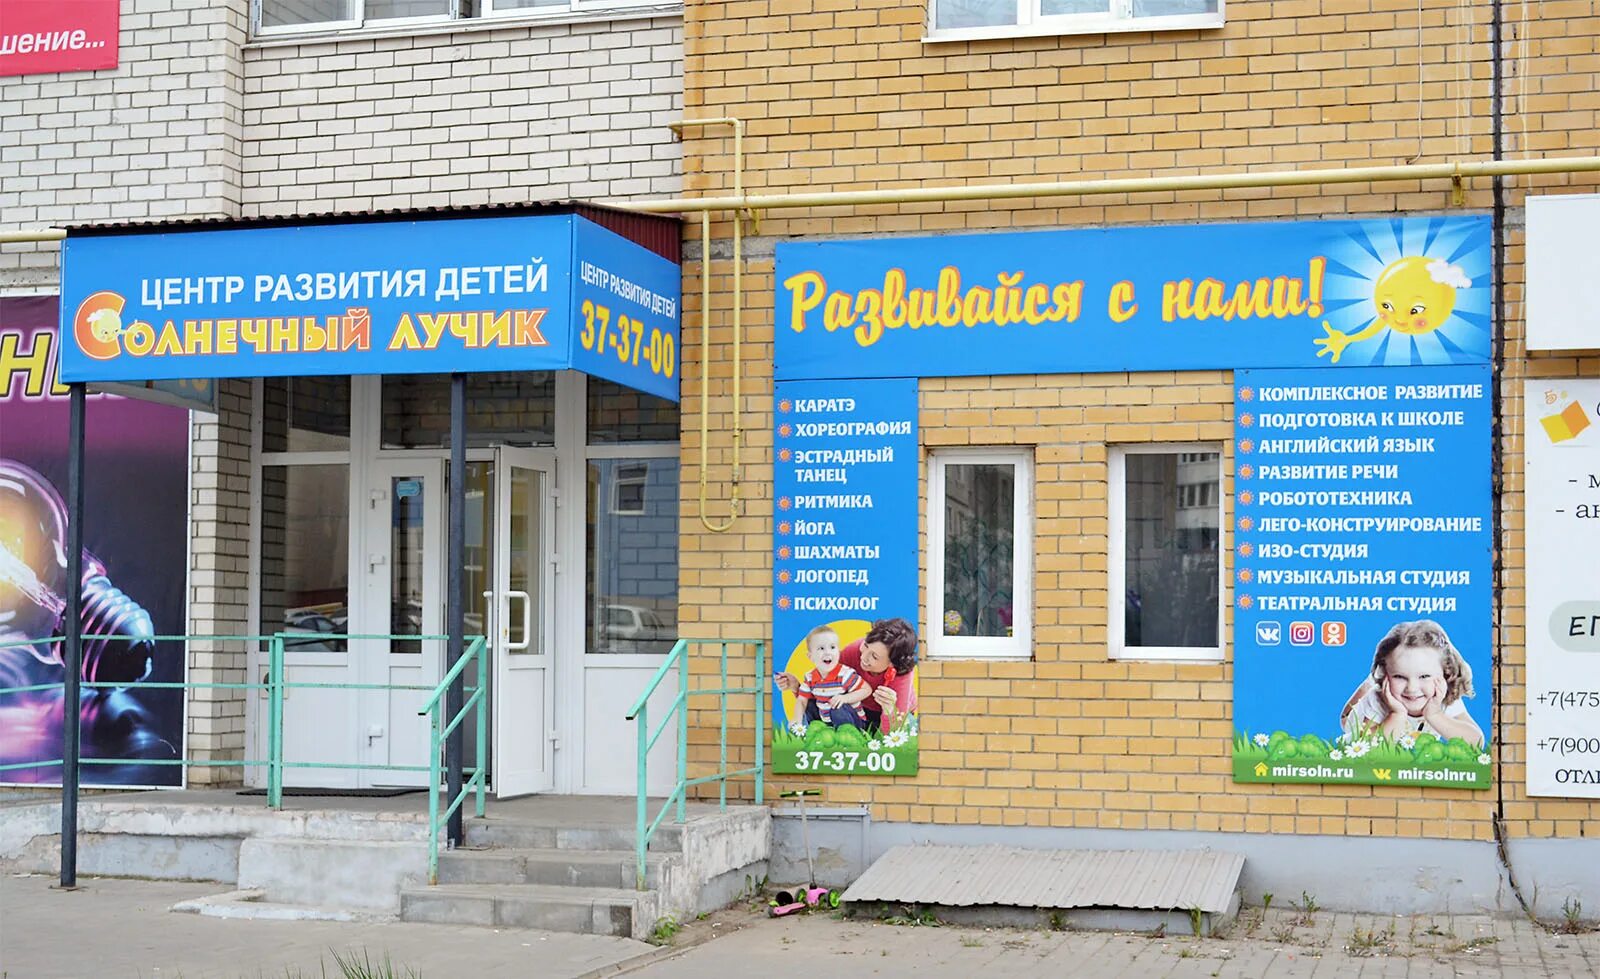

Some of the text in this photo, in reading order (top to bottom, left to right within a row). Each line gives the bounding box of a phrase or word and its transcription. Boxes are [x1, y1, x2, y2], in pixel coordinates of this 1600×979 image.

[141, 256, 549, 311] ЦЕНТР РАЗВИТИЯ ДЕТЕЙ
[581, 261, 676, 319] ЦЕНТР РАЗВИТИЯ ДЕТЕЙ
[783, 255, 1327, 347] Развивайся с нами!
[386, 307, 550, 351] ЛУЧИК
[581, 299, 675, 378] 37-37-00
[1259, 384, 1483, 402] КОМПЛЕКСНОЕ РАЗВИТИЕ
[795, 399, 855, 412] КАРАТЭ
[795, 421, 911, 436] ХОРЕОГРАФИЯ
[1259, 411, 1464, 431] ПОДГОТОВКА К ШКОЛЕ
[1258, 436, 1435, 454] АНГЛИЙСКИЙ ЯЗЫК
[794, 446, 894, 466] ЭСТРАДНЫЙ
[795, 468, 847, 484] ТАНЕЦ
[1259, 464, 1399, 480] РАЗВИТИЕ РЕЧИ
[794, 495, 873, 509] РИТМИКА
[1258, 491, 1413, 506] РОБОТОТЕХНИКА
[794, 519, 836, 536] ЙОГА
[1258, 517, 1482, 533] ЛЕГО-КОНСТРУИРОВАНИЕ
[794, 545, 880, 559] ШАХМАТЫ
[1258, 543, 1369, 561] ИЗО-СТУДИЯ
[793, 569, 870, 586] ЛОГОПЕД
[1257, 570, 1471, 588] МУЗЫКАЛЬНАЯ СТУДИЯ
[793, 597, 880, 611] ПСИХОЛОГ
[1257, 596, 1457, 614] ТЕАТРАЛЬНАЯ СТУДИЯ
[1537, 691, 1600, 711] +7(475
[1537, 737, 1600, 757] +7(900
[794, 751, 896, 772] 37-37-00
[1272, 764, 1354, 779] mirsoln.ru
[1397, 767, 1477, 783] mirsolnru
